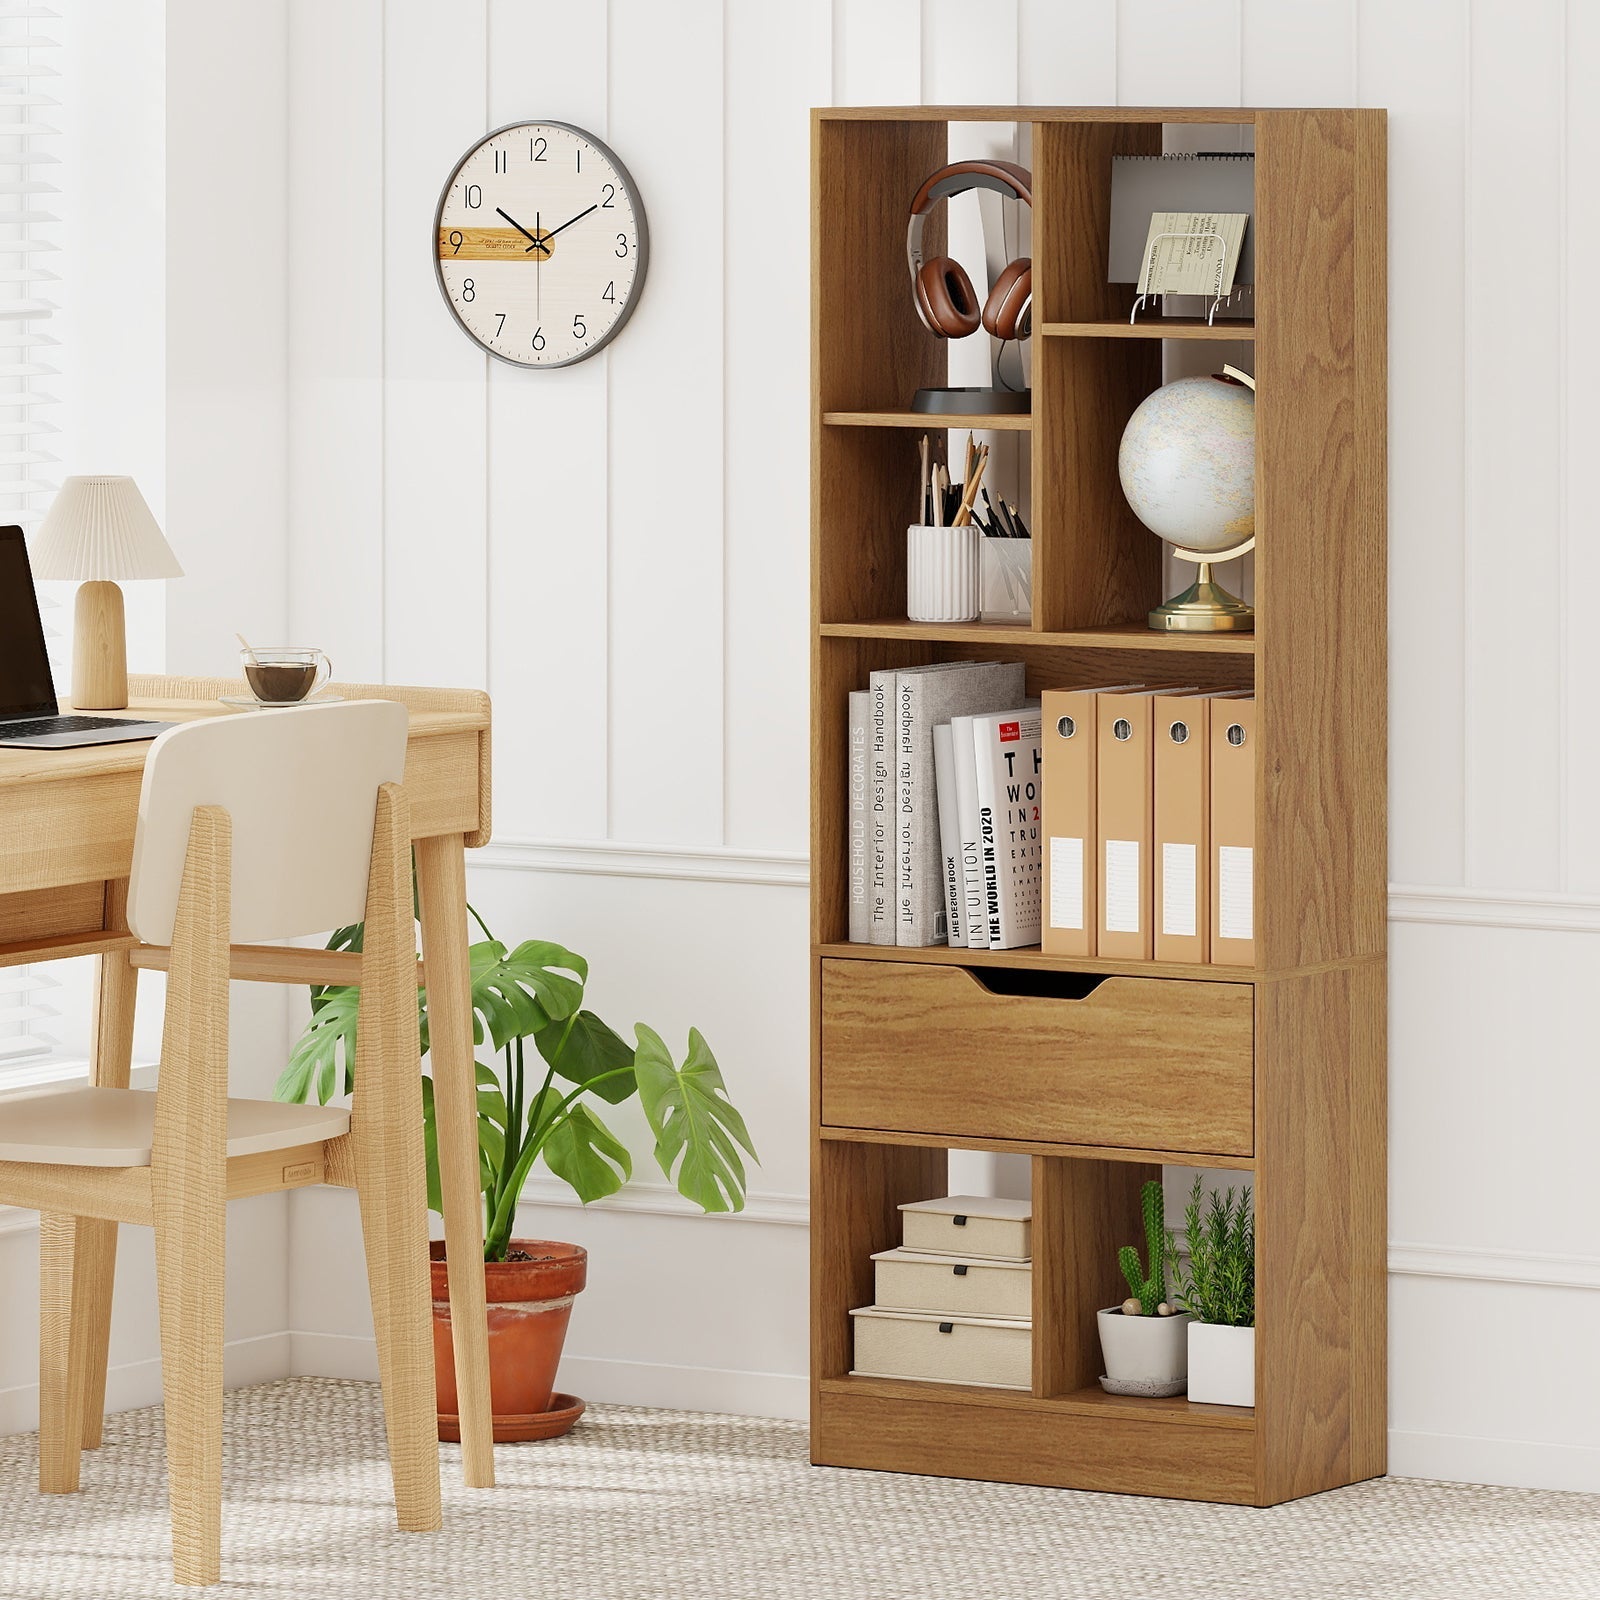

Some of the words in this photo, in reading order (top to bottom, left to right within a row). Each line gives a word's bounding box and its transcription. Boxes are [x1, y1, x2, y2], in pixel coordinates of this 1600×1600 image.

[495, 149, 507, 174] 11
[531, 137, 547, 162] 12
[577, 149, 581, 174] 1
[464, 184, 482, 209] 10
[602, 184, 615, 208] 2
[449, 230, 463, 255] 9
[615, 233, 628, 258] 3
[462, 278, 476, 303] 8
[602, 280, 615, 304] 4
[495, 313, 506, 338] 7
[572, 314, 587, 339] 5
[532, 327, 546, 351] 6
[873, 684, 885, 752] Handbook
[855, 727, 865, 810] DECORATES
[873, 760, 887, 812] Design
[981, 807, 994, 844] 2020
[853, 820, 865, 904] HOUSEHOLD
[873, 821, 885, 888] Interior
[984, 847, 995, 861] IN
[963, 842, 983, 941] INTUITION
[985, 864, 999, 914] WORLD
[873, 898, 885, 922] The
[989, 917, 1001, 943] THE
